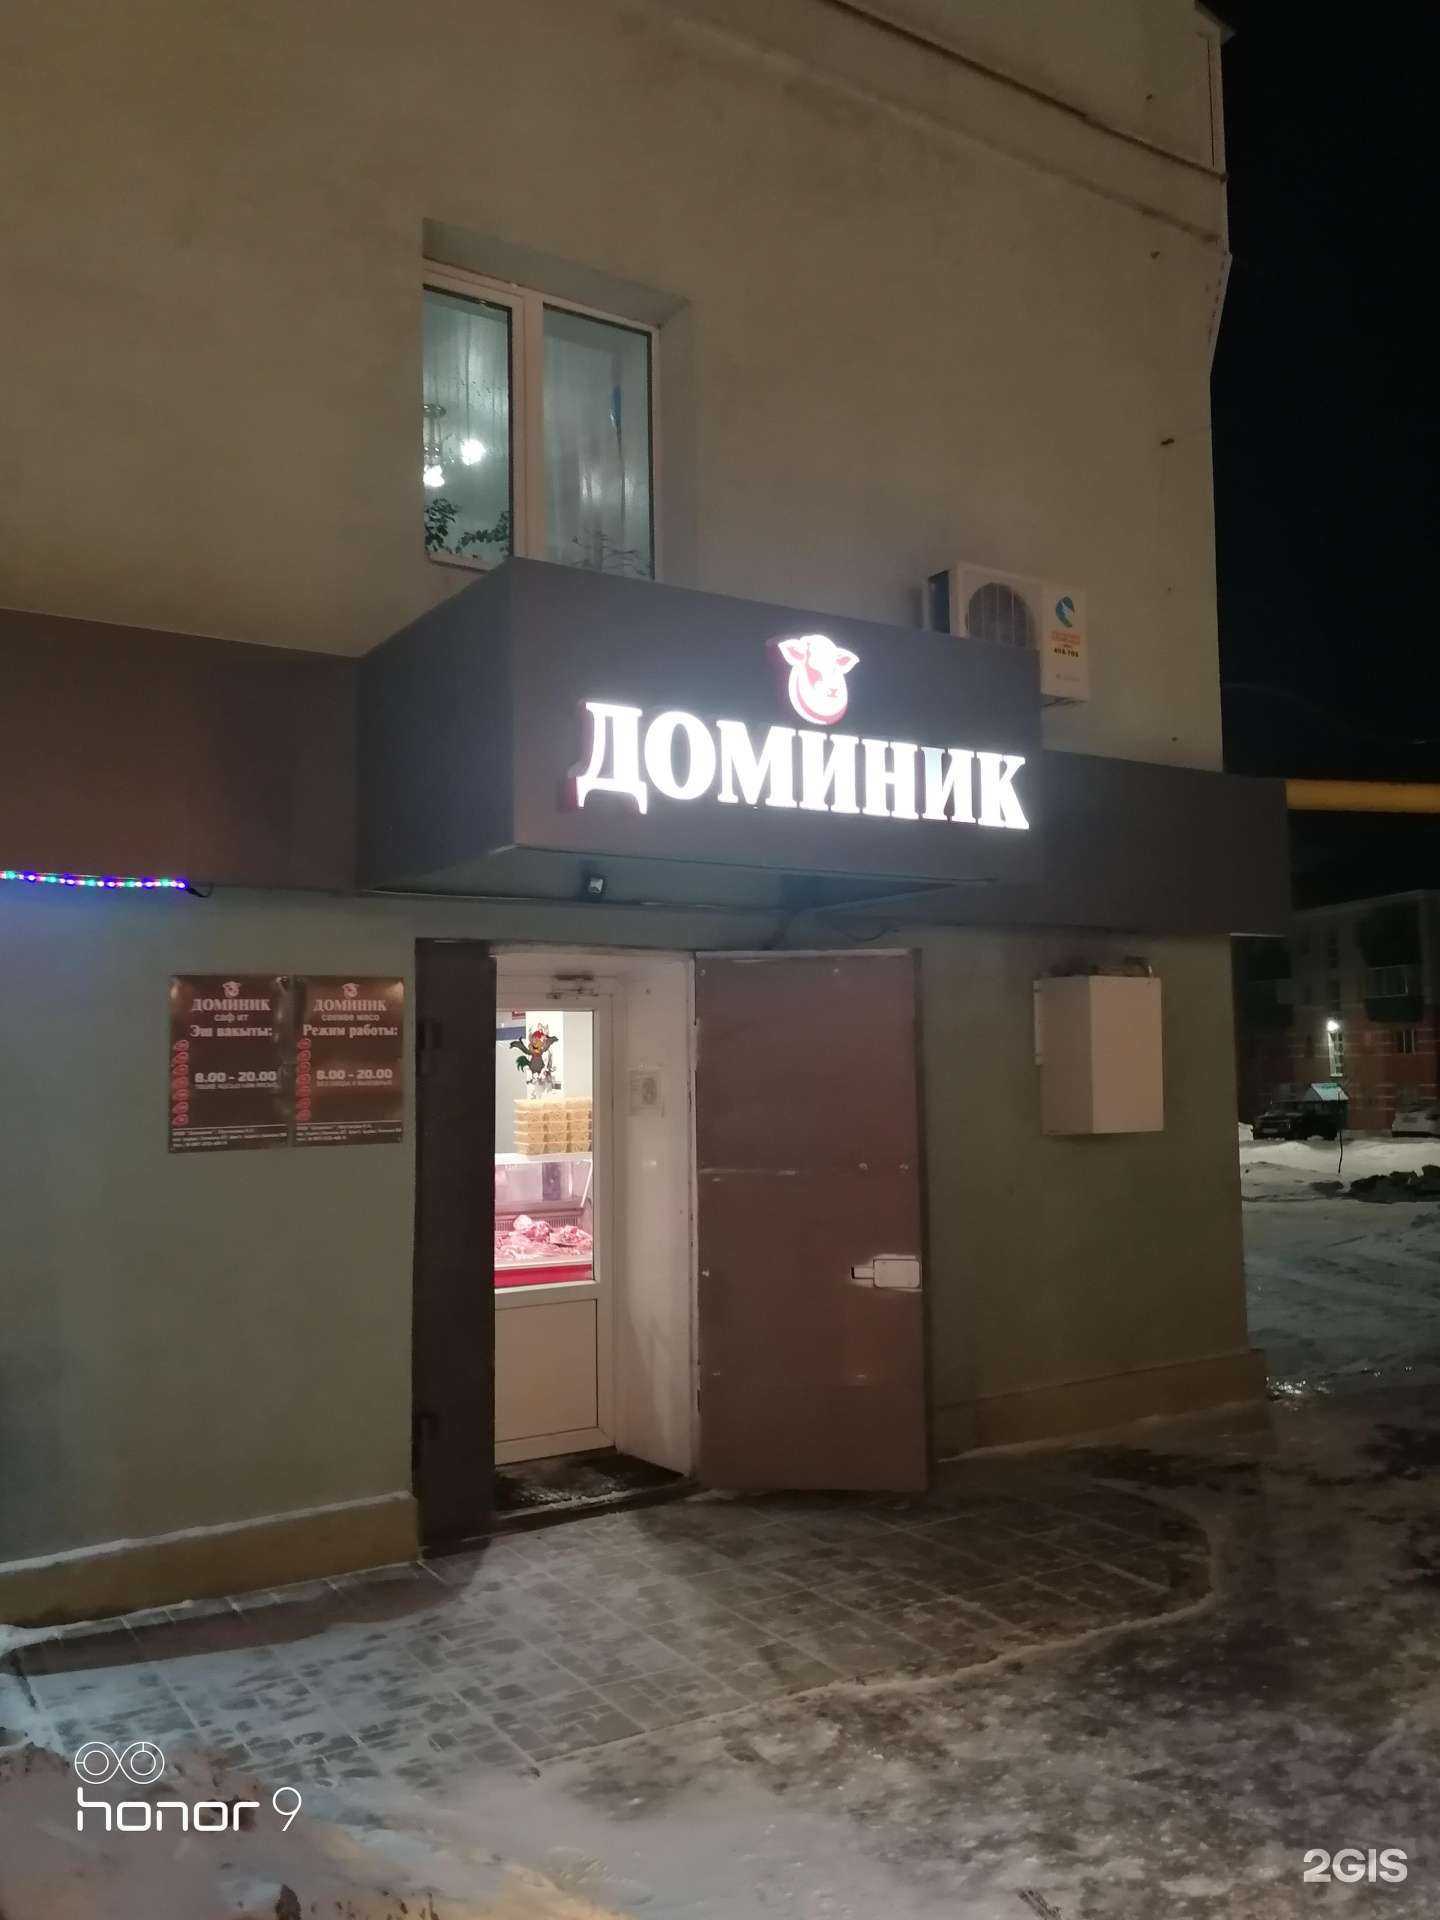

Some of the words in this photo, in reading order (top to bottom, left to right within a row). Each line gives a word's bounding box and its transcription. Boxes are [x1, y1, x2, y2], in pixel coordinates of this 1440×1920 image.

[577, 702, 1029, 830] ДОМИНИК
[192, 998, 272, 1011] ДОМИНИК
[313, 999, 387, 1012] ДОМИНИК
[303, 1024, 345, 1036] Режим
[349, 1024, 398, 1038] работы:
[238, 1071, 277, 1082] 20.00
[357, 1069, 393, 1079] 20.00
